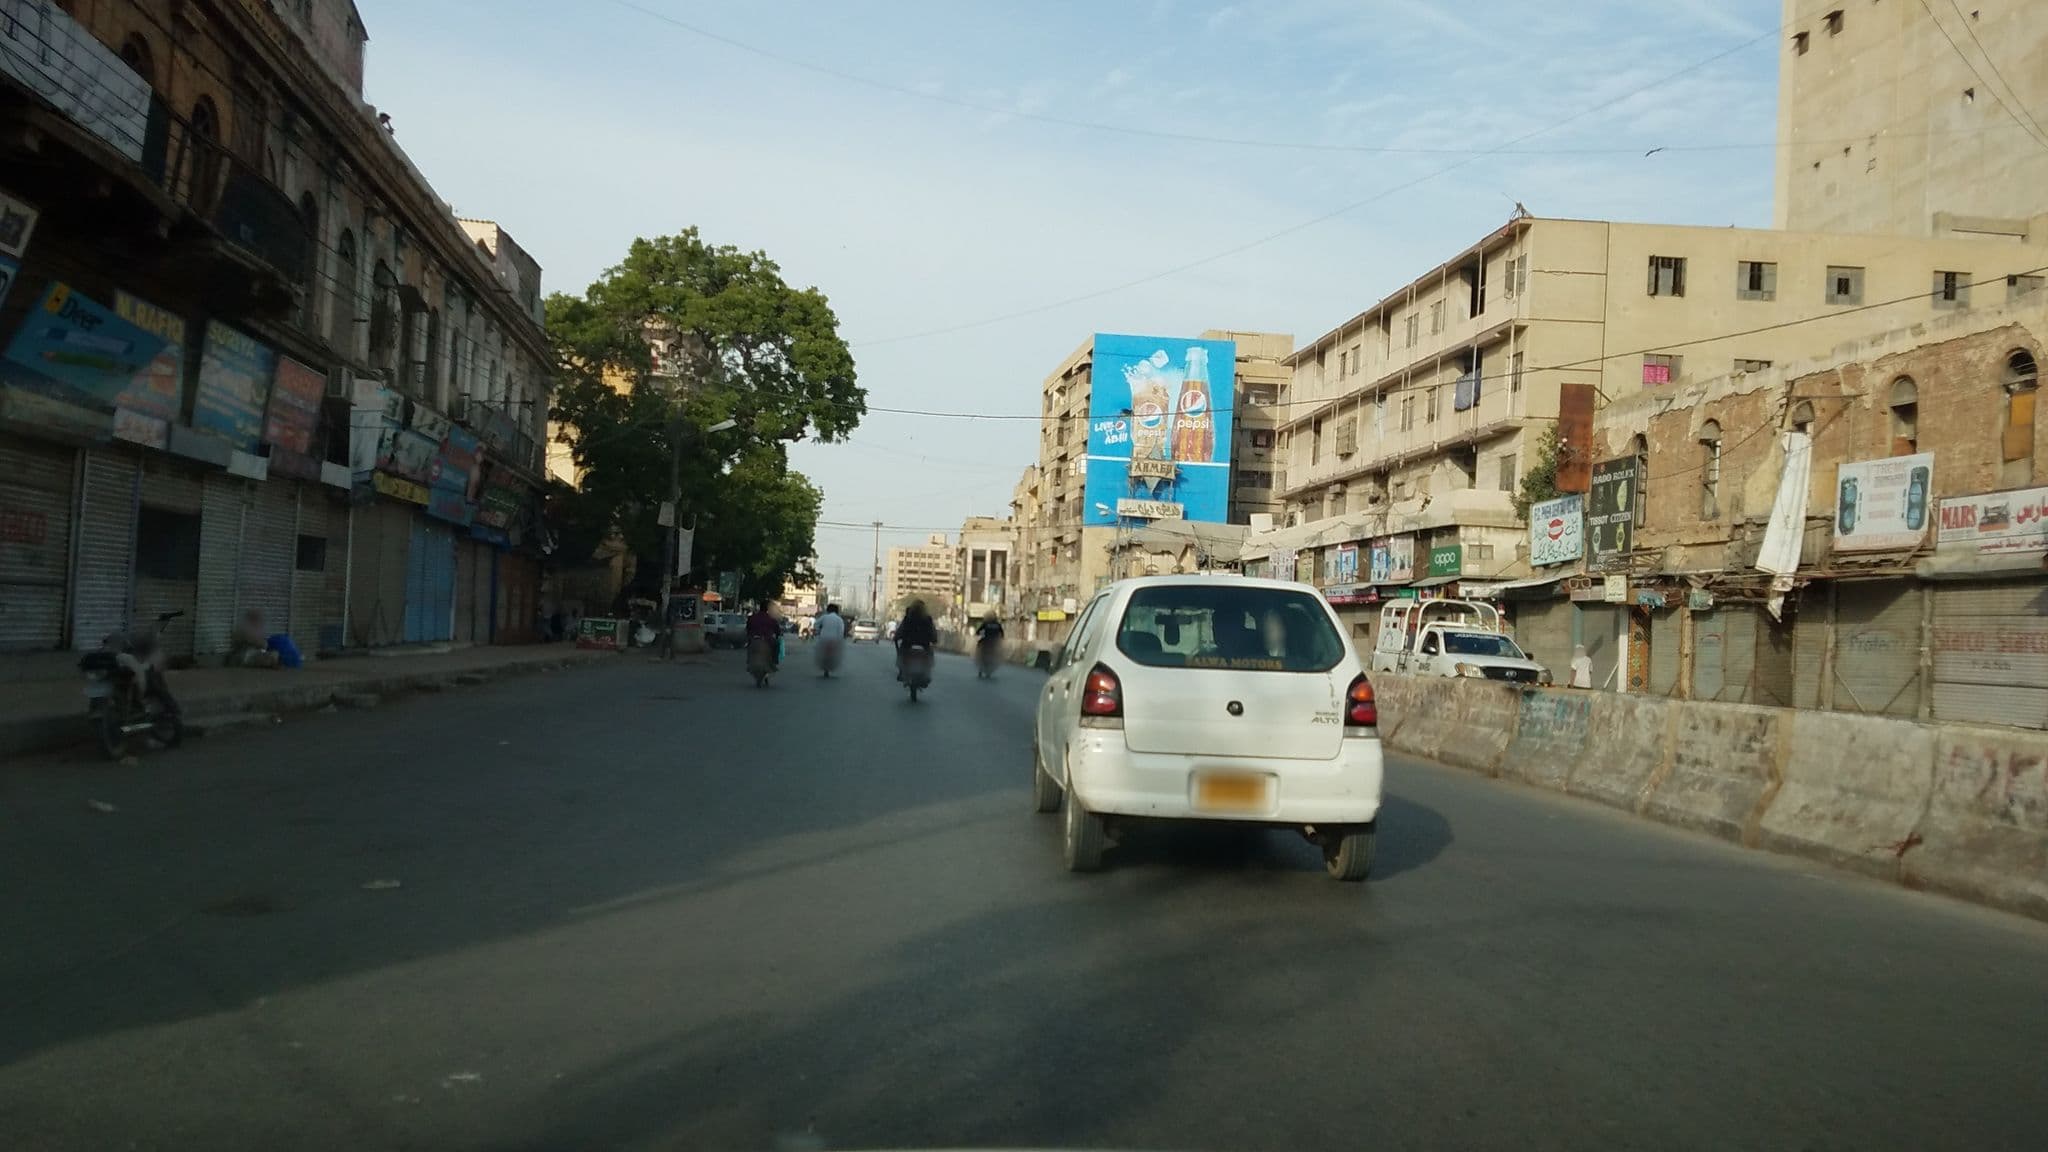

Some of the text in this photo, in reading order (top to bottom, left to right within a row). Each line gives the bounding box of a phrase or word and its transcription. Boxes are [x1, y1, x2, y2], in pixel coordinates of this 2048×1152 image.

[1177, 418, 1209, 431] pepsi
[1593, 468, 1634, 485] RADO ROLEX
[1942, 504, 1978, 530] MARS
[1434, 552, 1456, 566] oppo
[1311, 716, 1340, 725] ALTO
